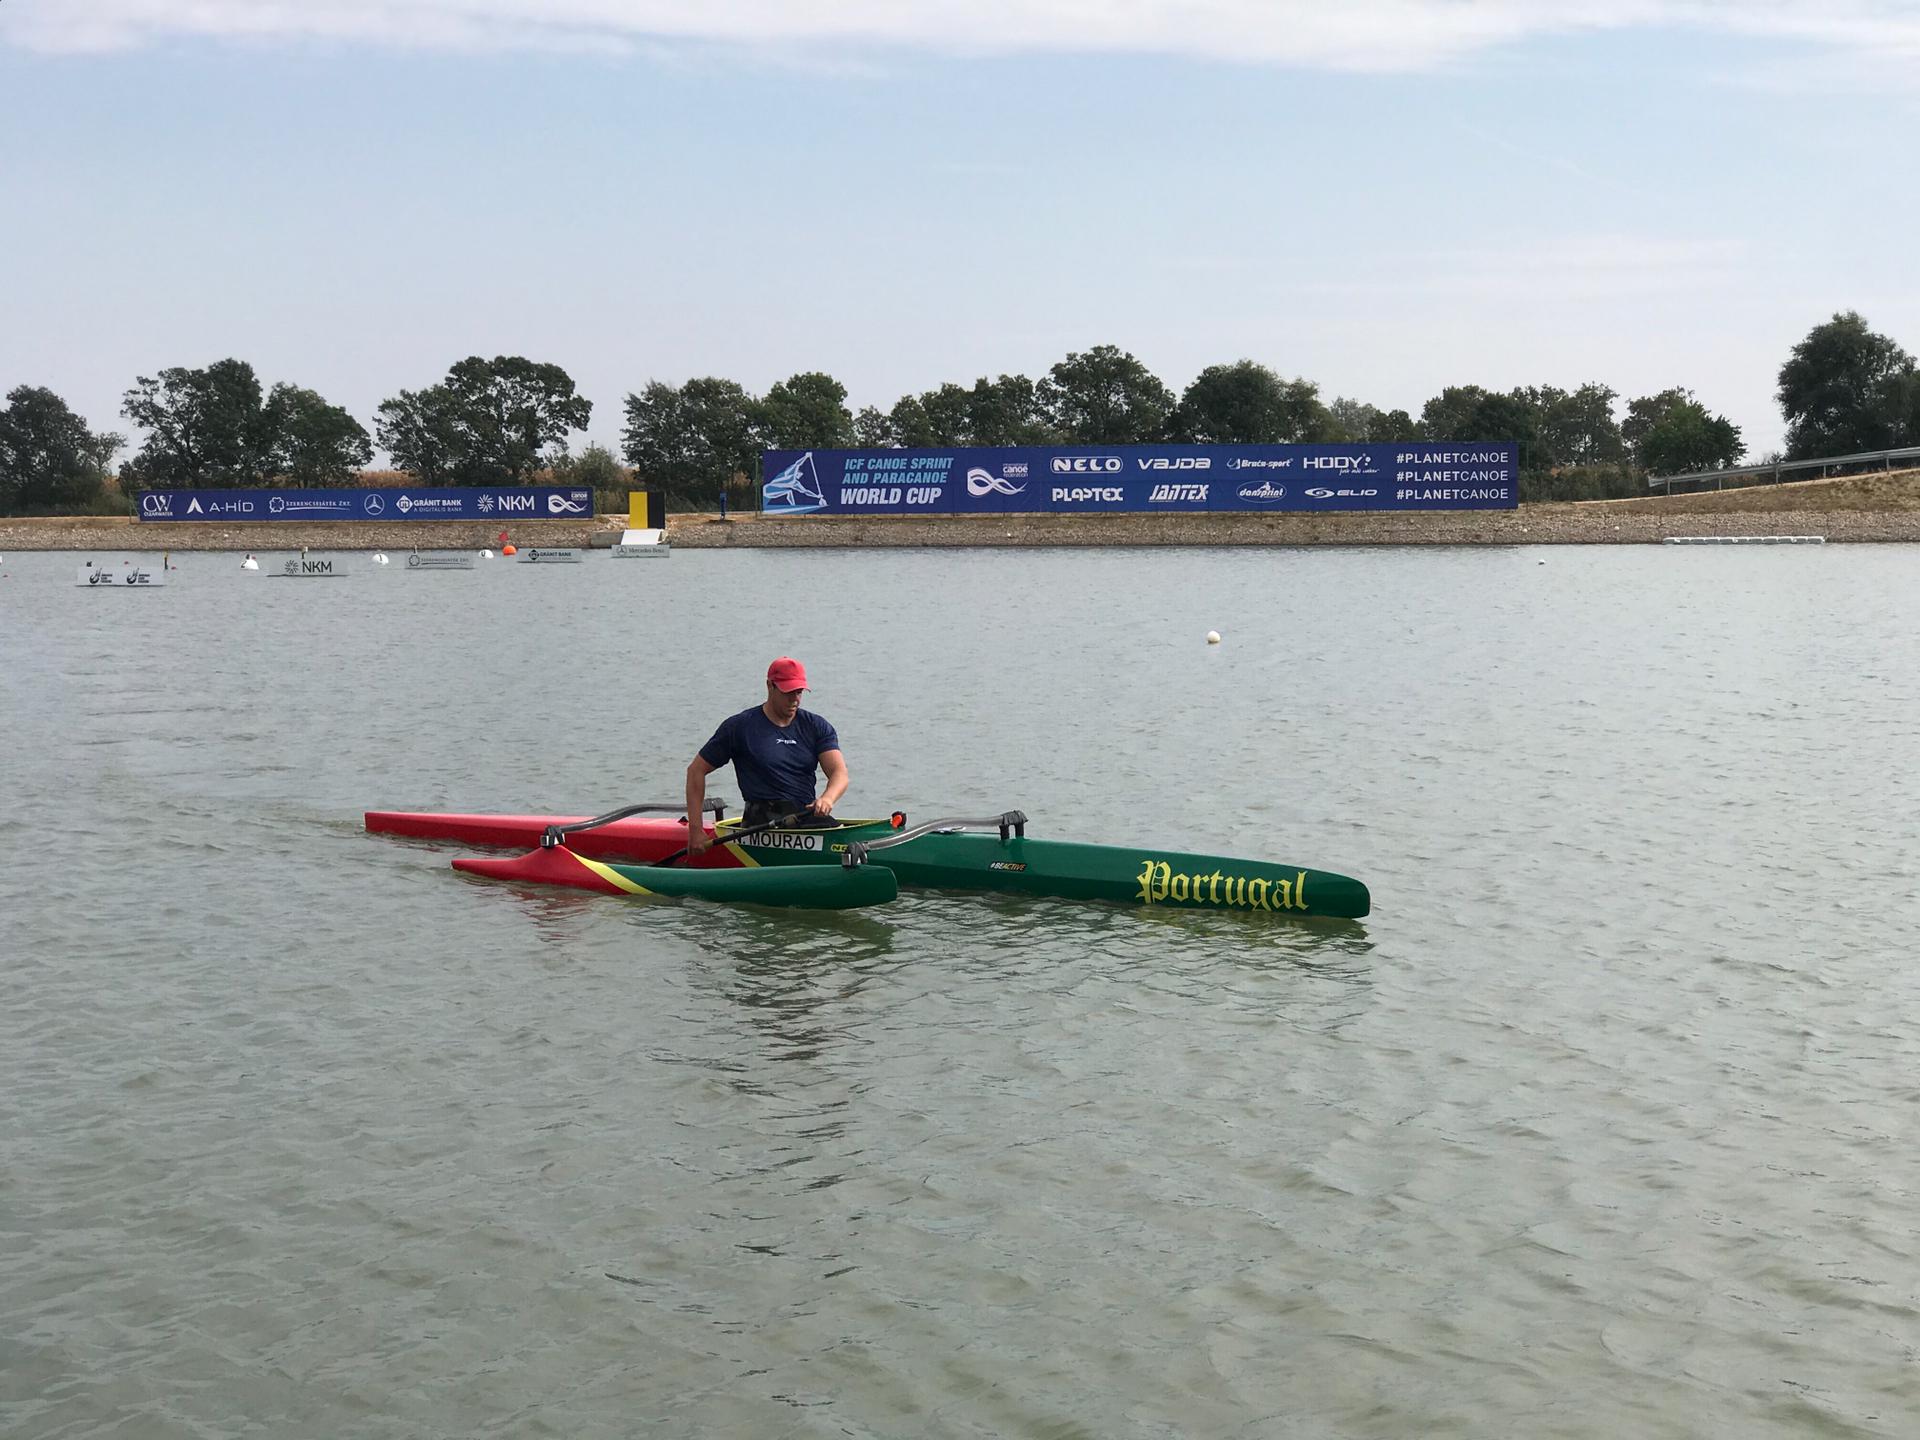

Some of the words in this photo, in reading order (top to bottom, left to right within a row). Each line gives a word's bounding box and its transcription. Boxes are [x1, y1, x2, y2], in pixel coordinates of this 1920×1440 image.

[845, 458, 864, 470] ICF
[867, 458, 908, 470] CANOE
[911, 457, 954, 470] SPRINT
[1303, 457, 1363, 469] HODY
[1396, 452, 1509, 463] #PLANETCANOE
[1053, 458, 1121, 471] NELO
[842, 472, 869, 485] AND
[872, 471, 948, 485] PARACANOE
[1396, 470, 1509, 481] #PLANETCANOE
[840, 487, 902, 505] WORLD
[906, 486, 942, 504] CUP
[1396, 488, 1509, 499] #PLANETCANOE
[208, 499, 254, 513] A-HÍD
[498, 495, 535, 511] NKM
[302, 561, 332, 573] NKM
[749, 832, 816, 850] MOURAO
[1135, 860, 1309, 911] Portugal
